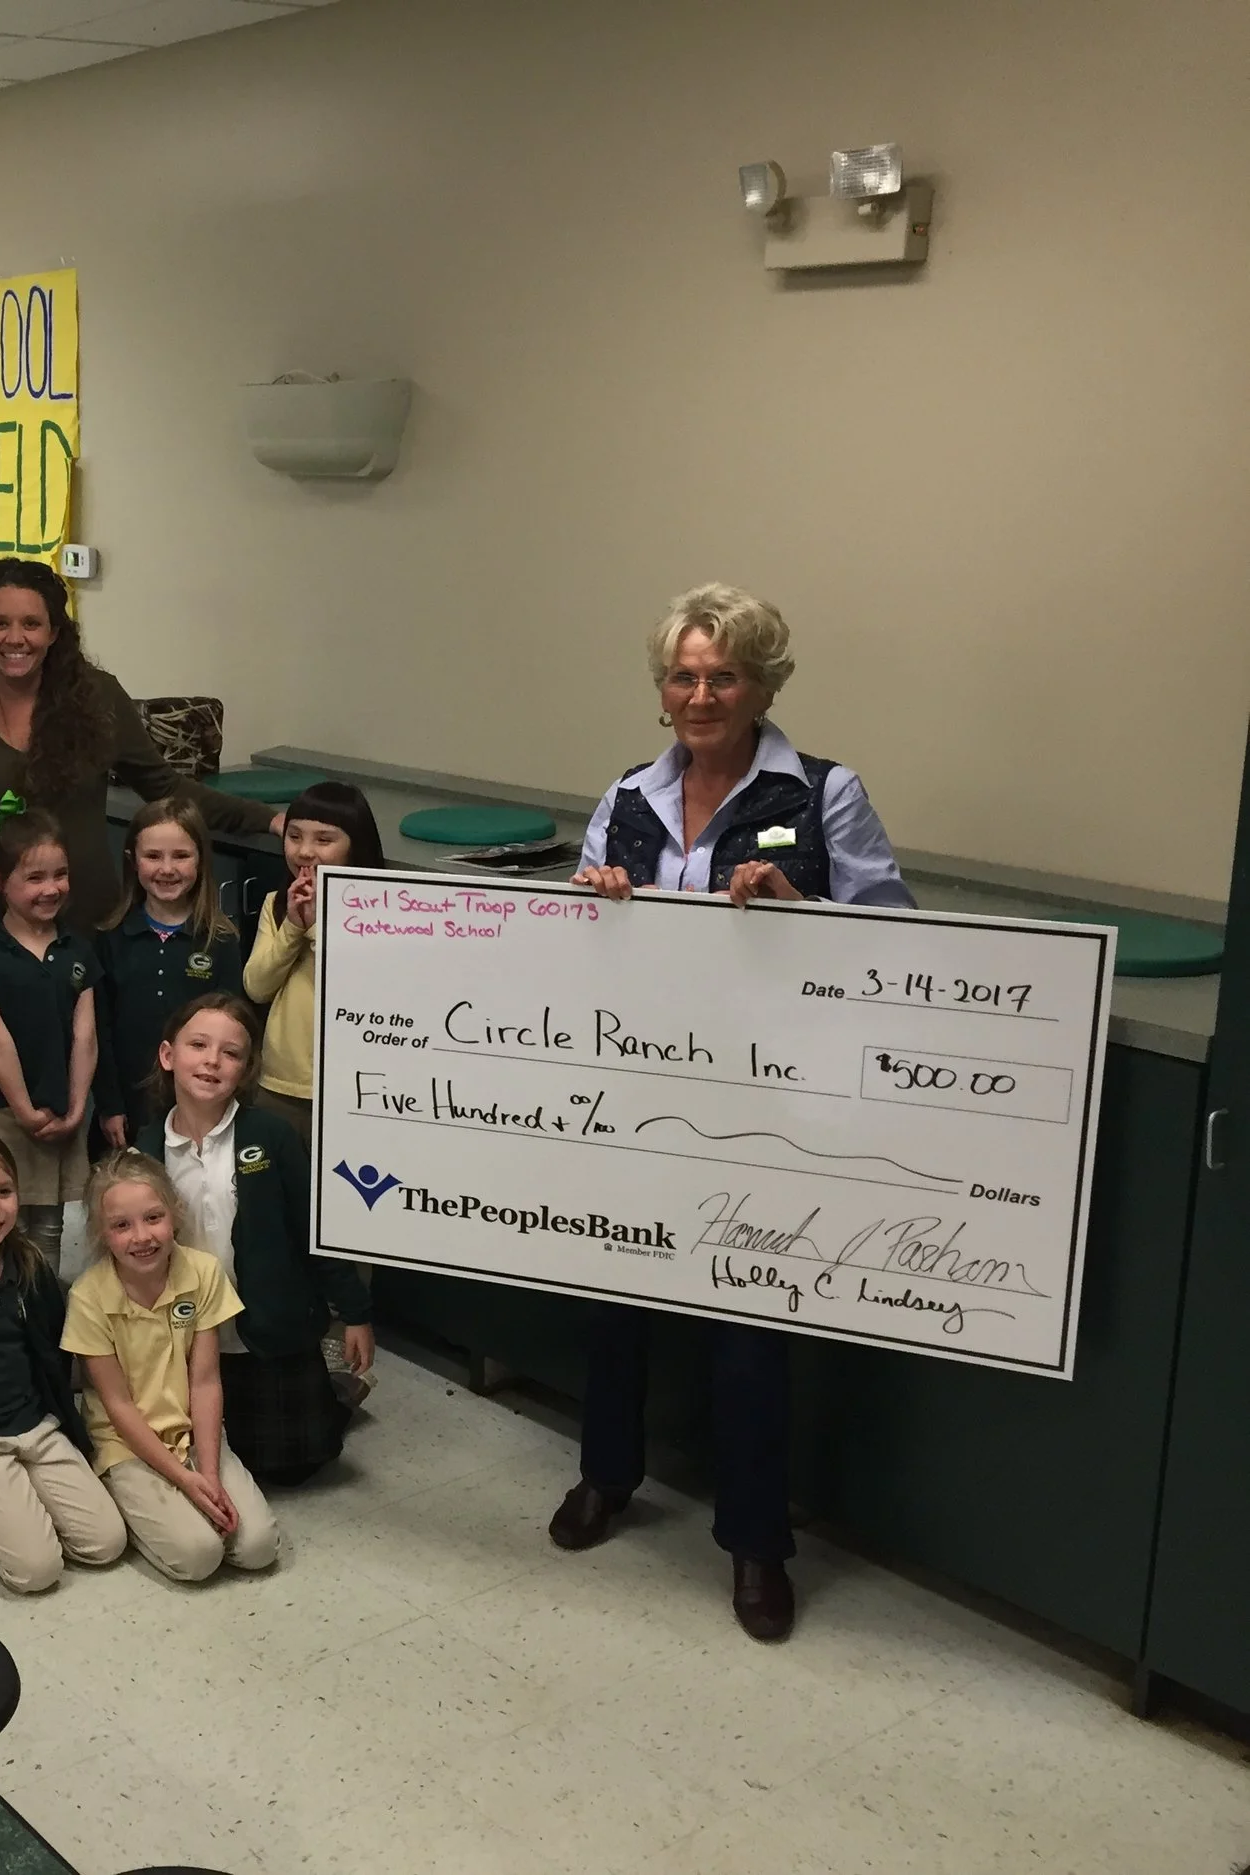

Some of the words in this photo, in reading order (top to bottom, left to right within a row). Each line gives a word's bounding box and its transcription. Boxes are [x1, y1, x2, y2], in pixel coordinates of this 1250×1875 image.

[341, 883, 388, 909] Girl
[397, 889, 456, 914] Scout
[455, 891, 517, 922] Troop
[343, 915, 434, 938] Gatewood
[443, 920, 502, 938] School
[801, 980, 846, 1000] Date
[861, 968, 1033, 1013] 3-14-2017
[335, 1008, 365, 1026] Pay
[369, 1012, 384, 1026] to
[389, 1014, 414, 1029] the
[362, 1030, 408, 1048] Order
[411, 1036, 430, 1049] of
[444, 1000, 574, 1050] Circle
[594, 1009, 714, 1064] Ranch
[750, 1042, 807, 1082] Inc.
[356, 1070, 424, 1115] Five
[431, 1077, 548, 1133] Hundred
[968, 1183, 1042, 1208] Dollars
[398, 1186, 678, 1250] ThePeoplesBank
[616, 1244, 651, 1257] Member
[652, 1249, 676, 1261] FDIC
[711, 1254, 805, 1313] Holly
[856, 1277, 1016, 1334] Lindsey
